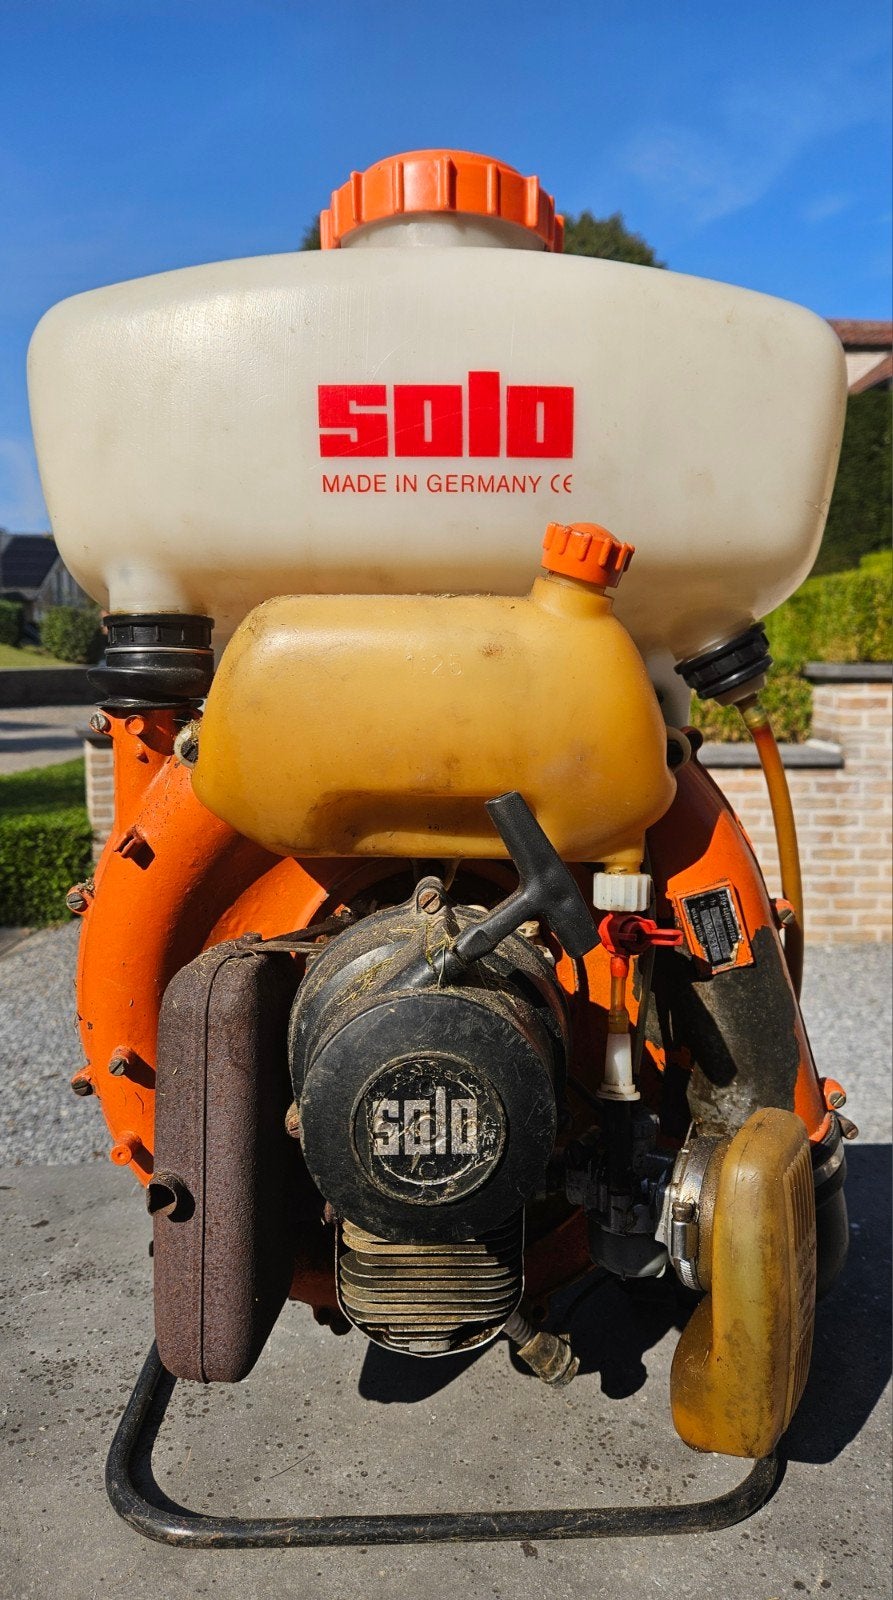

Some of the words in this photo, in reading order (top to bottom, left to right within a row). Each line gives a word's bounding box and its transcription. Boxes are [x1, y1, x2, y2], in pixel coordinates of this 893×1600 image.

[318, 371, 574, 458] solo
[322, 474, 386, 493] MADE
[395, 475, 417, 492] IN
[426, 474, 540, 493] GERMANY
[372, 1086, 478, 1156] solo
